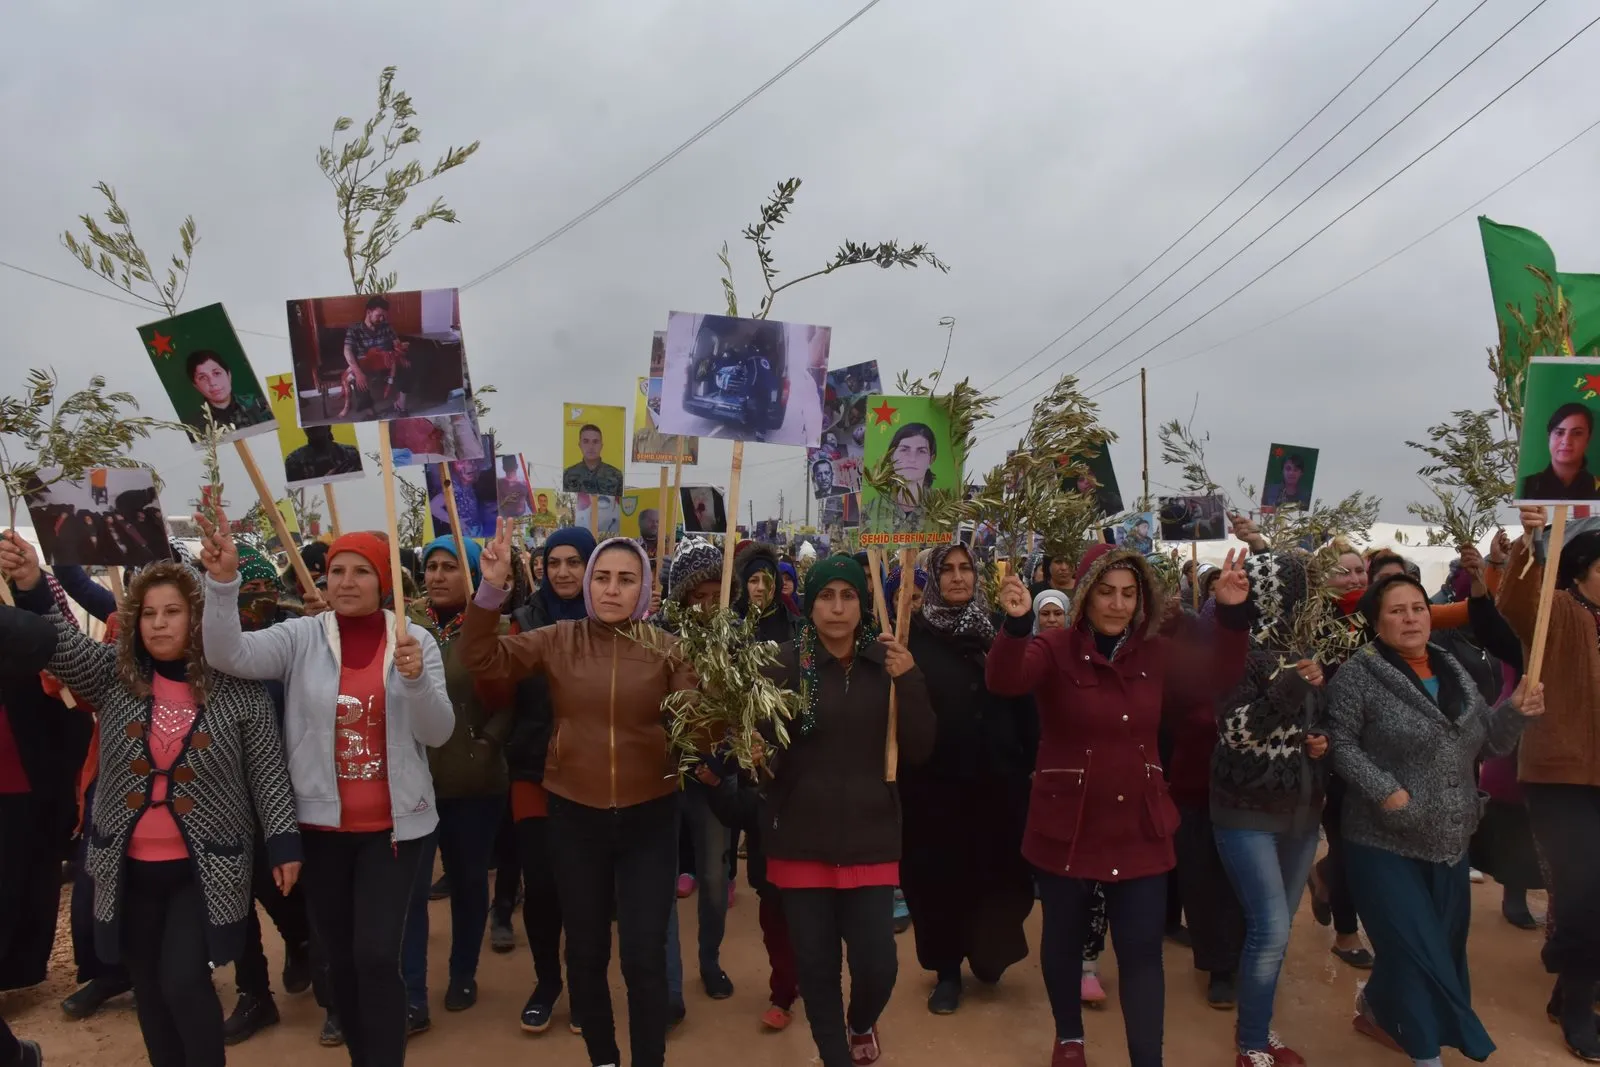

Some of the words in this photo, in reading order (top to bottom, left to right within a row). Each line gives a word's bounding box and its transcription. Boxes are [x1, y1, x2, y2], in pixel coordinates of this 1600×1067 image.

[867, 412, 900, 434] YPJ
[861, 531, 890, 545] ŞEHİD
[926, 530, 953, 544] ZİLAN
